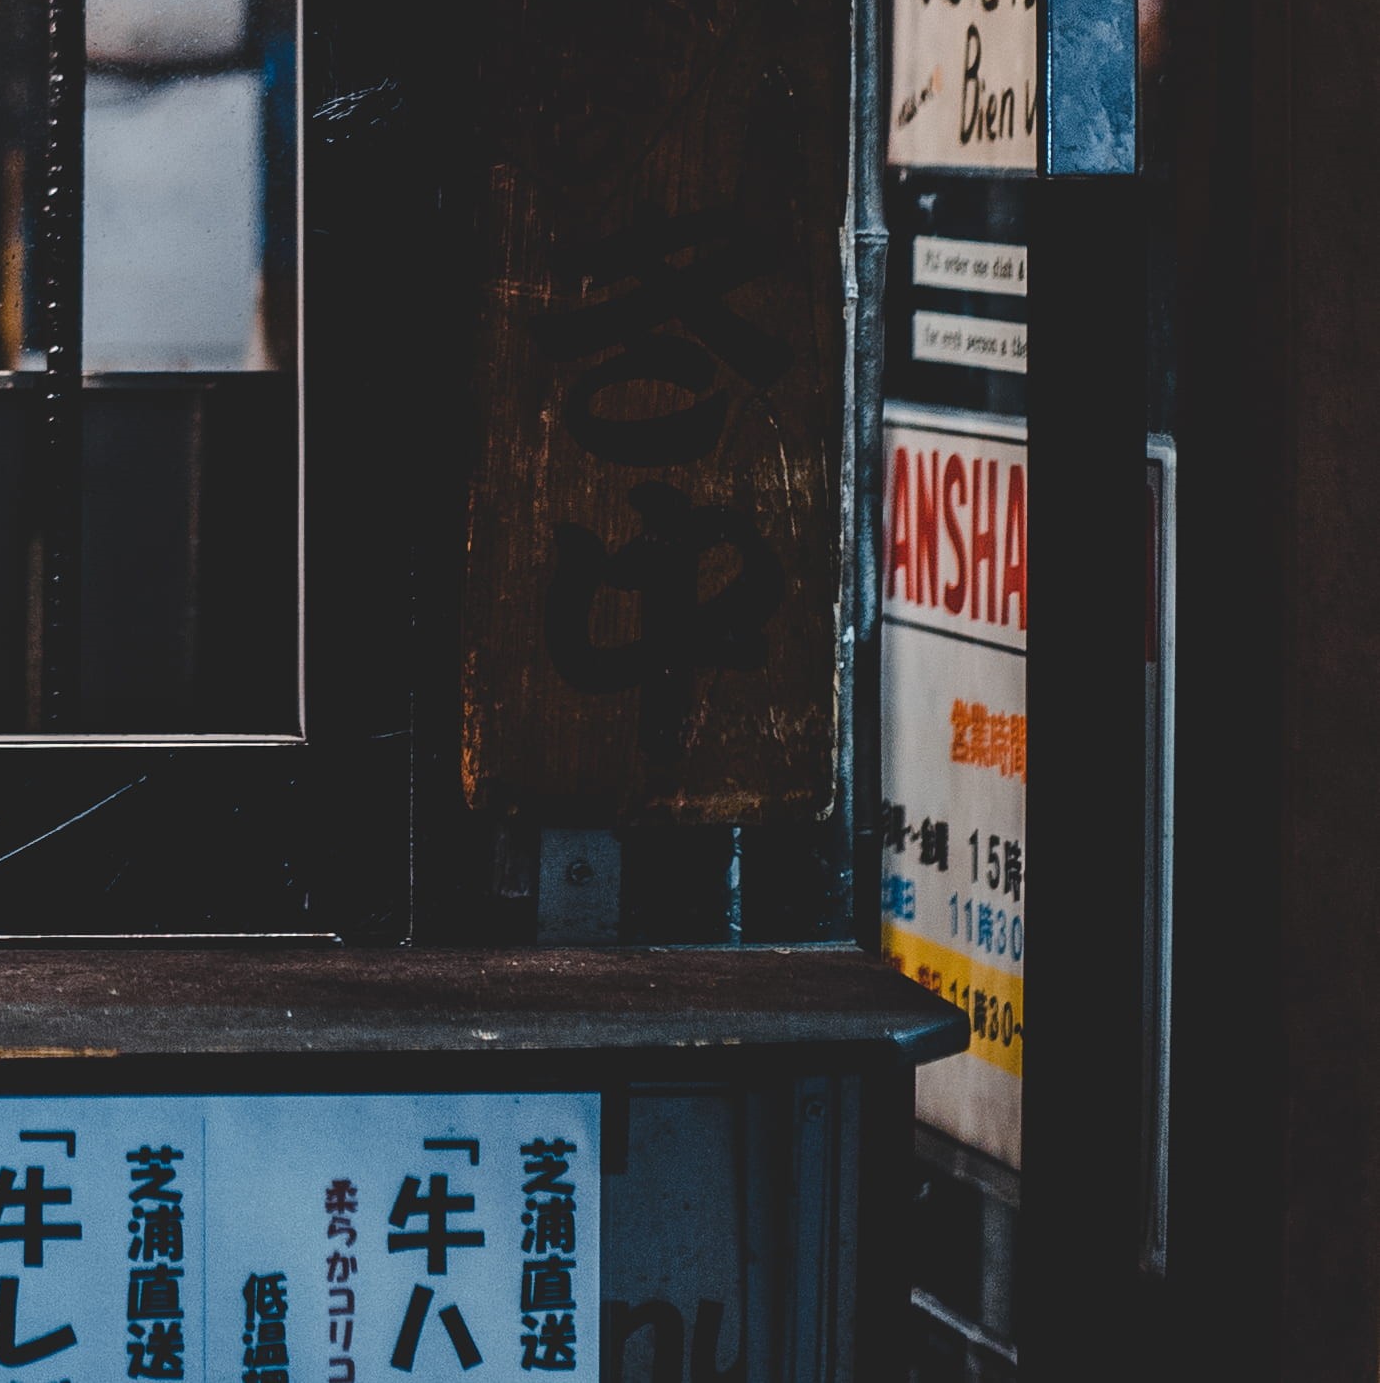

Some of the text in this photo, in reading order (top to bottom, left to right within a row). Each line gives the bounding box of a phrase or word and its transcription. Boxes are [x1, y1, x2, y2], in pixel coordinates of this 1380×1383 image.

[959, 22, 1015, 147] Bien
[887, 445, 1027, 630] ANSHA
[126, 1144, 185, 1380] 芝浦直送
[241, 1271, 289, 1383] 低温
[520, 1137, 577, 1372] 芝浦直送
